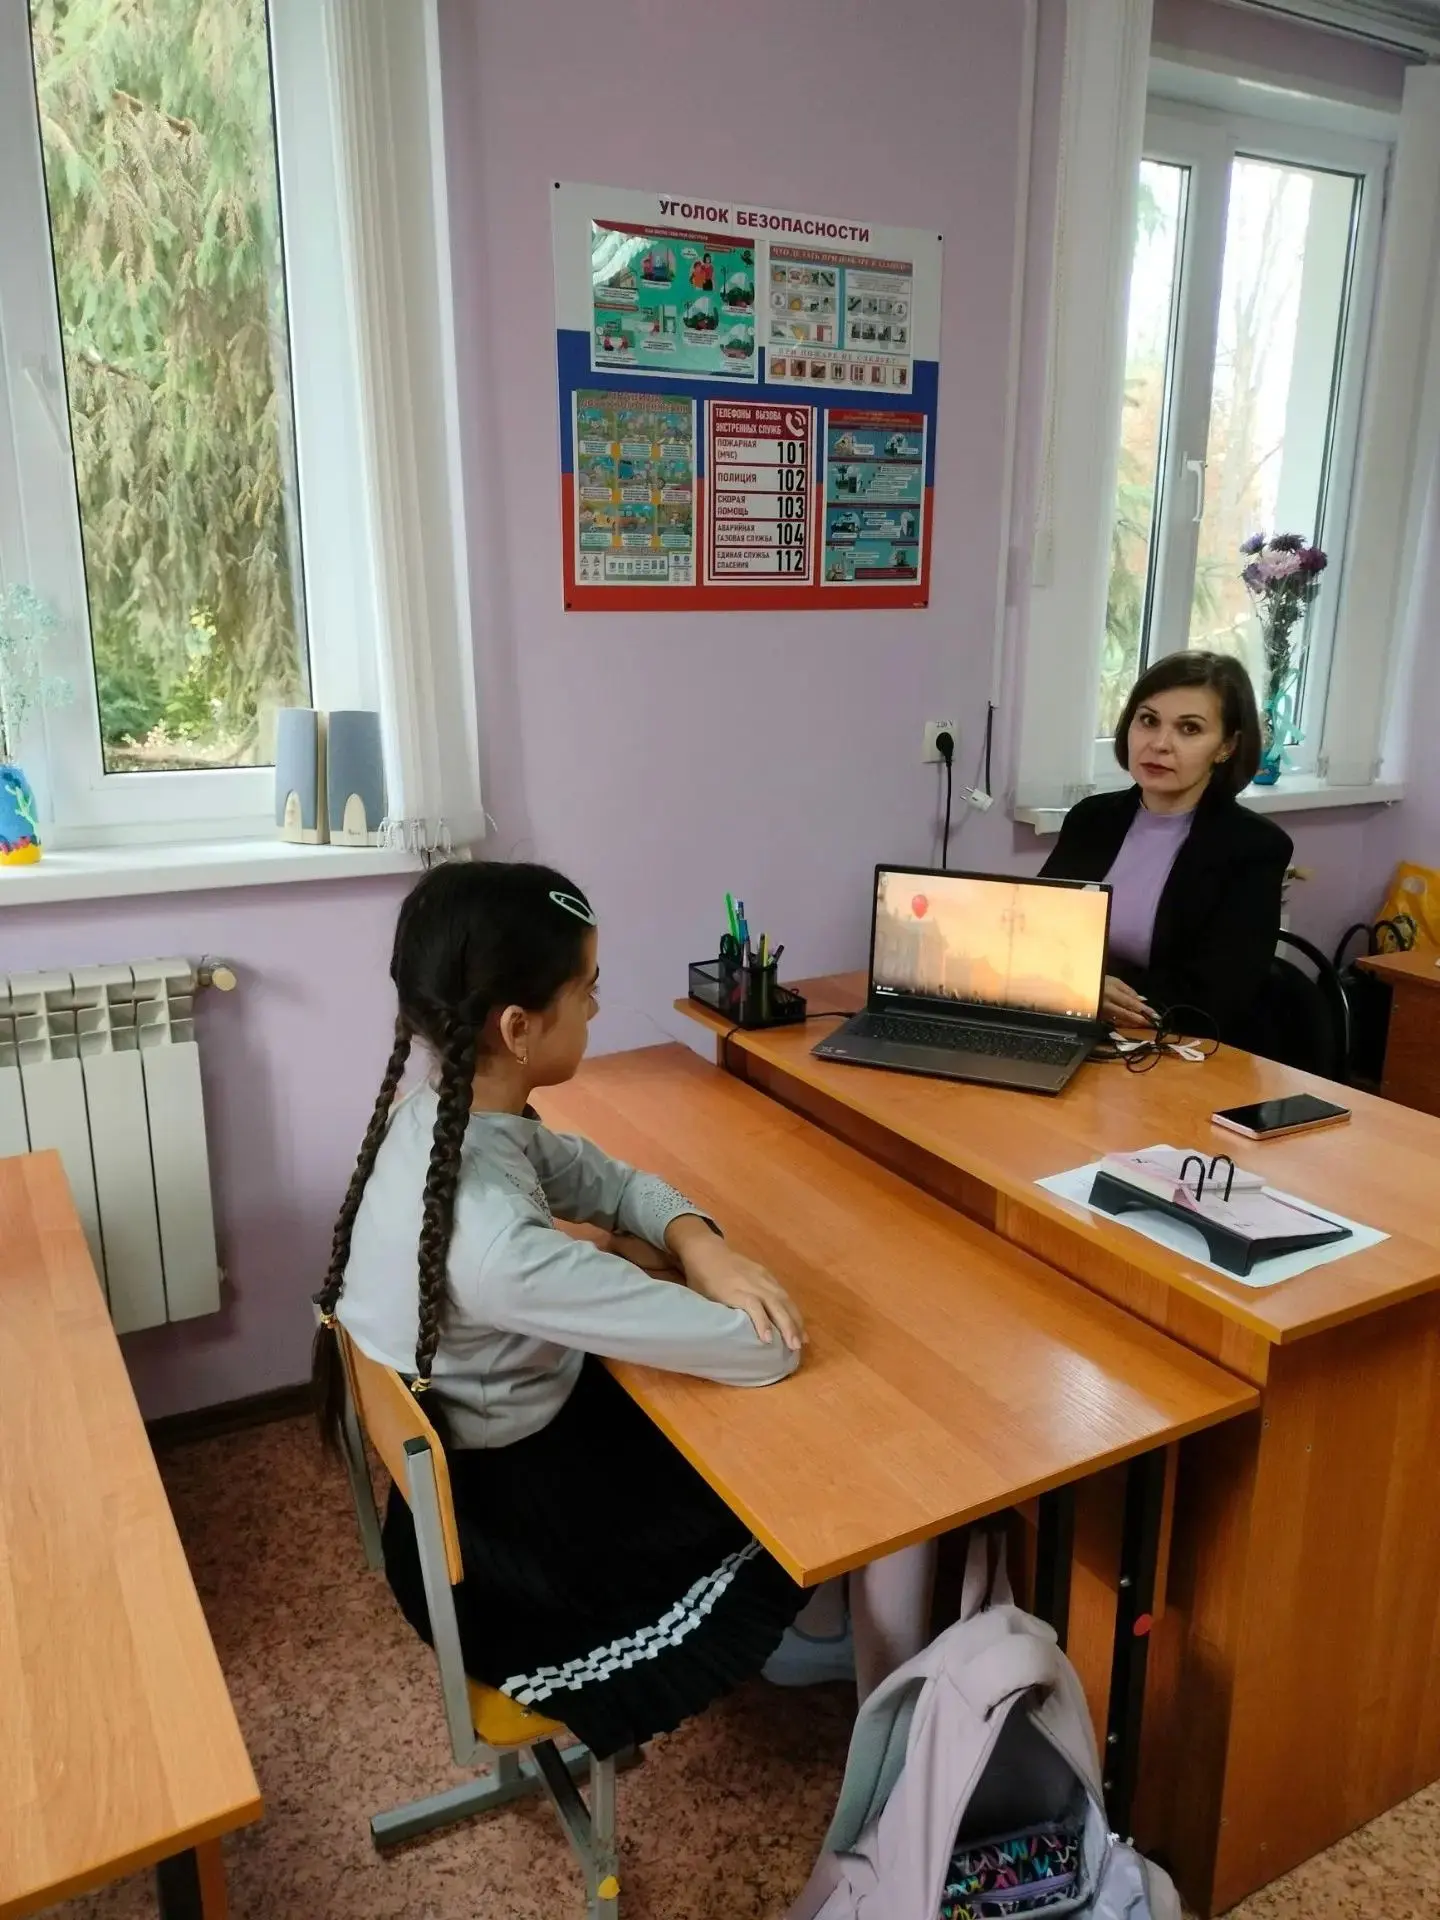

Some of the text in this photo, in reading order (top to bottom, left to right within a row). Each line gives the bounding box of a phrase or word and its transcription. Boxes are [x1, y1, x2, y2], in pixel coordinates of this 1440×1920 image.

[659, 200, 729, 223] УГОЛОК
[737, 211, 869, 242] БЕЗОПАСНОСТИ
[715, 408, 781, 420] ТЕЛЕФОНЫ ВЫЗОВА
[716, 423, 781, 435] ЭКСТРЕННЫХ СЛУЖБ
[717, 439, 757, 448] ПОЖАРНАЯ
[717, 450, 738, 460] (МЧС)
[777, 441, 805, 464] 101
[717, 472, 757, 484] ПОЛИЦИЯ
[777, 469, 805, 492] 102
[717, 495, 746, 503] СКОРАЯ
[717, 507, 749, 516] ПОМОЩЬ
[777, 496, 804, 518] 103
[717, 523, 755, 532] АВАРИЙНАЯ
[717, 534, 745, 542] ГАЗОВАЯ
[776, 523, 804, 545] 104
[717, 551, 770, 559] ЕДИНАЯ СЛУЖБА
[776, 550, 803, 571] 112
[717, 561, 749, 569] СПАСЕНИЯ
